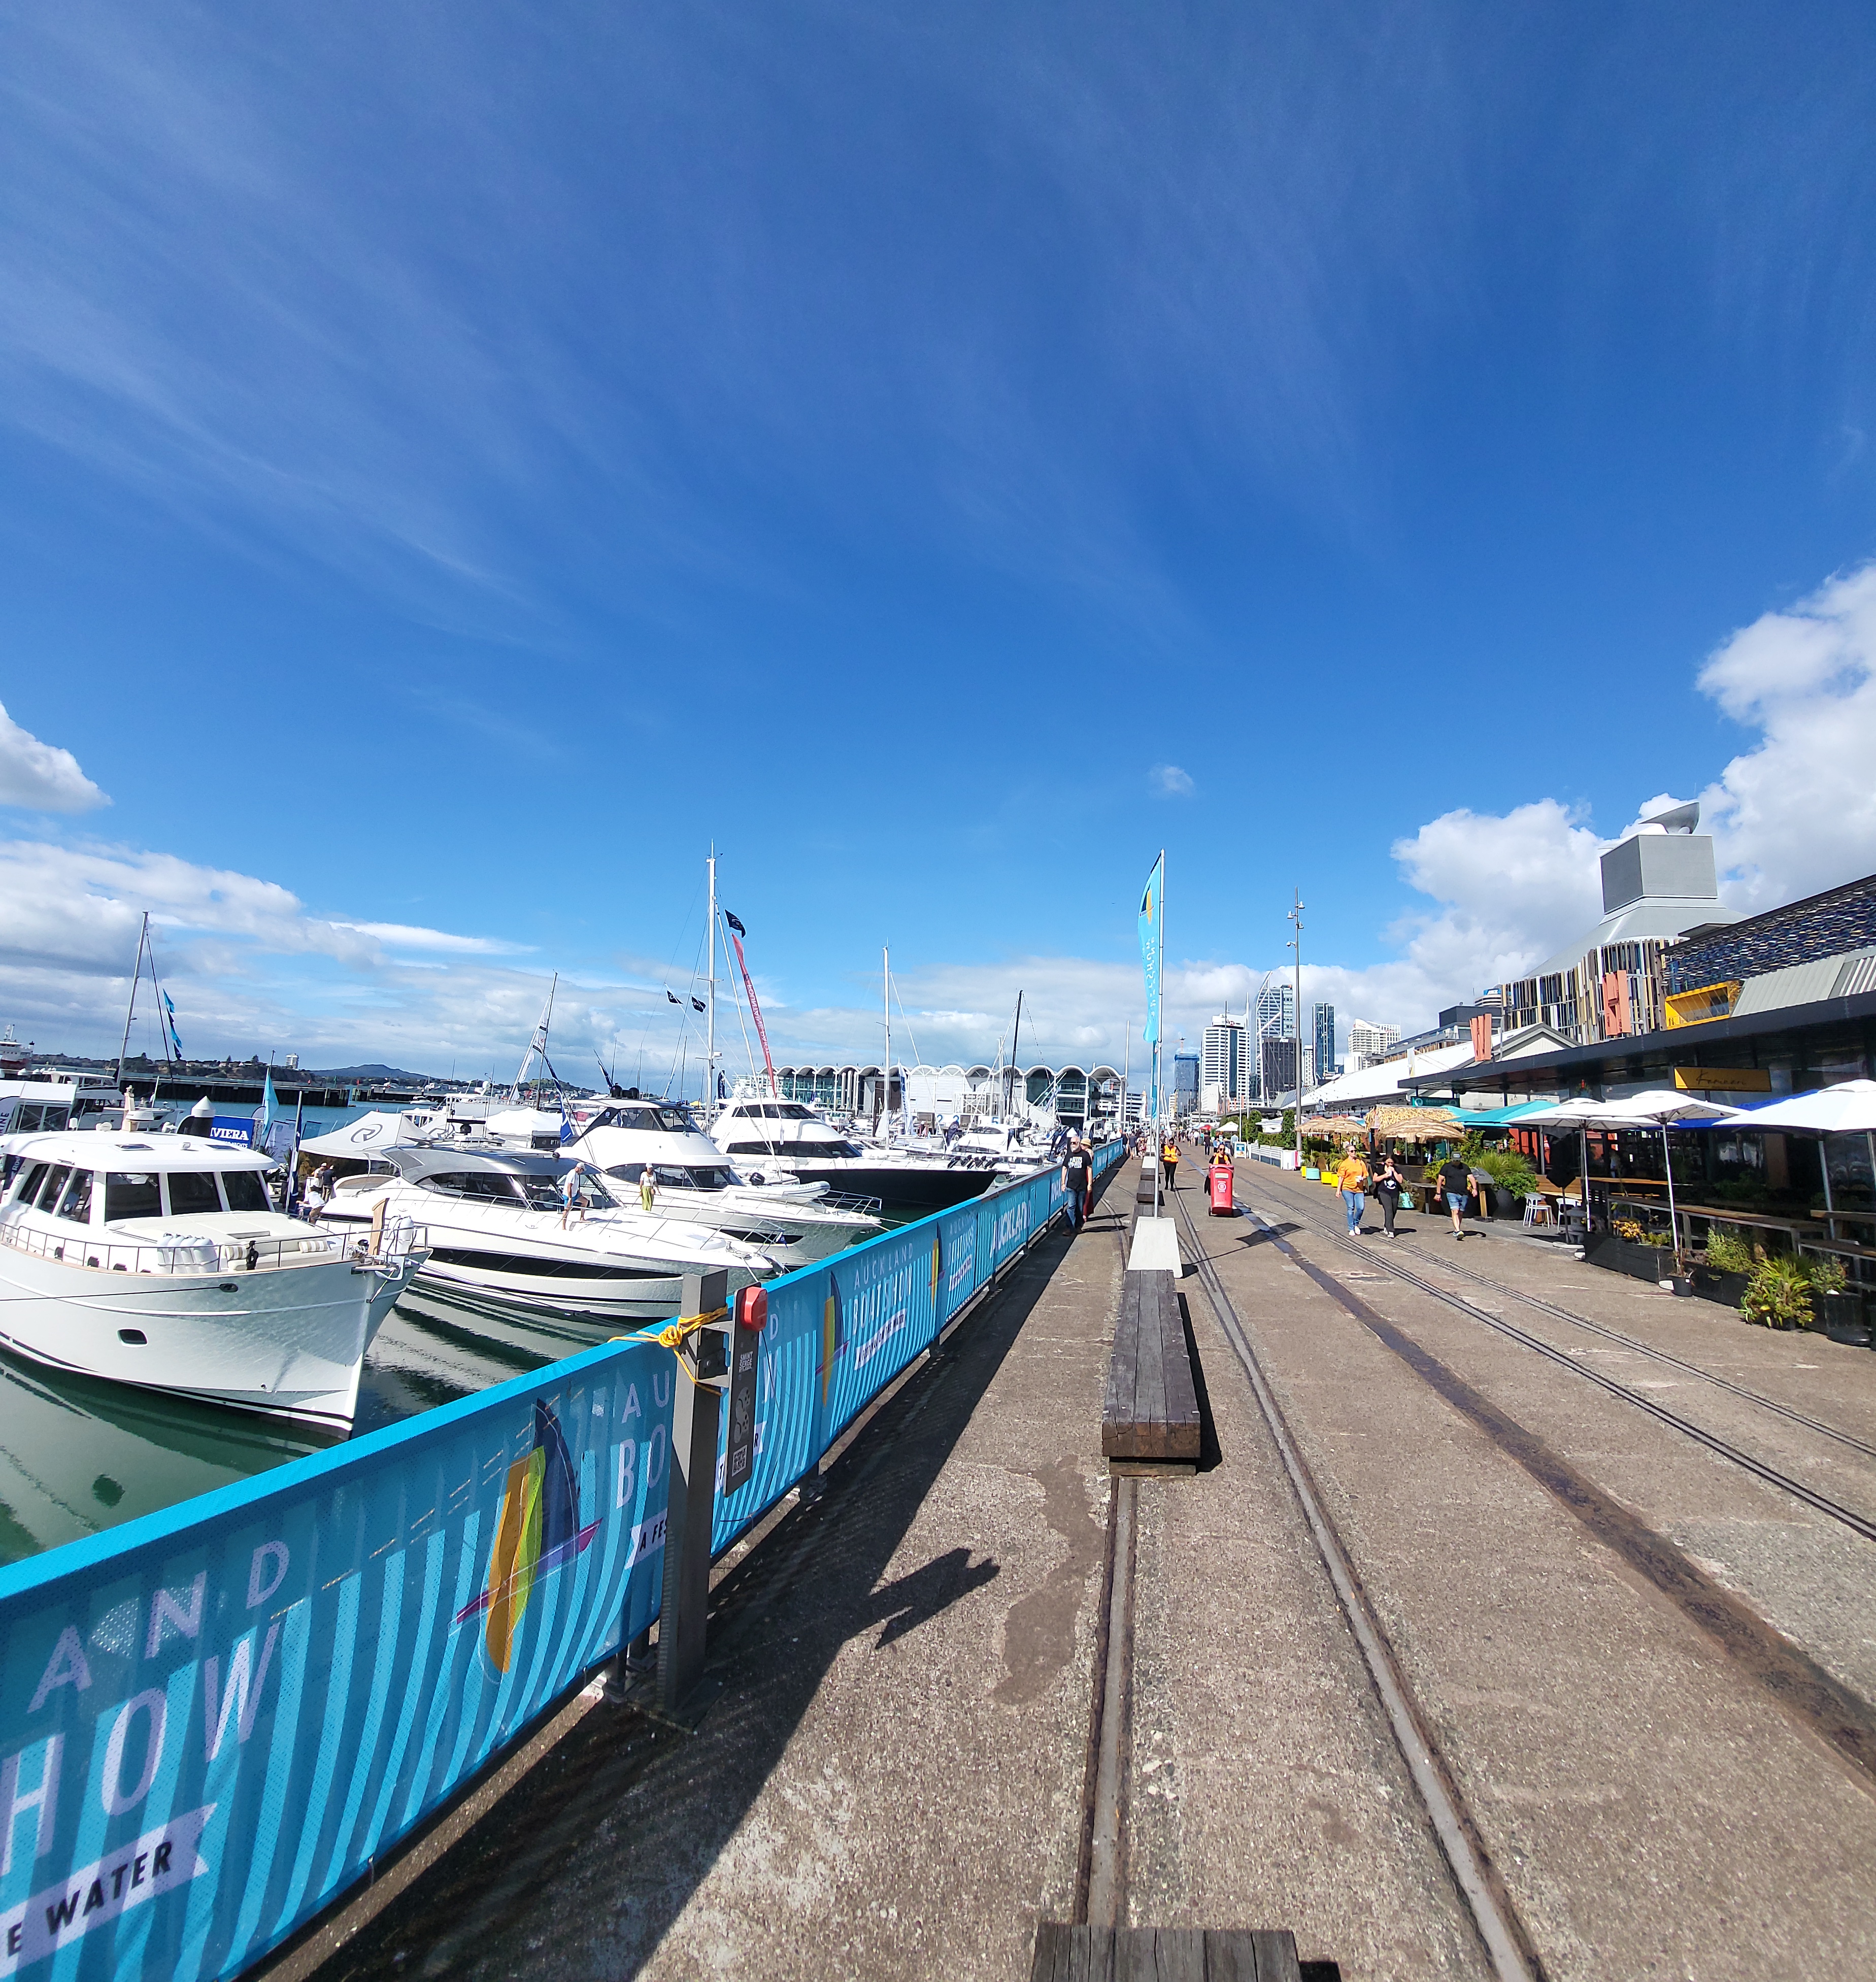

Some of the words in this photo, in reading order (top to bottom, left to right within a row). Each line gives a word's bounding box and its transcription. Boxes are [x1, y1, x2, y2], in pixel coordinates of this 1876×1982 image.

[854, 1243, 913, 1291] AUCKLAND
[858, 1352, 861, 1363] A
[862, 1337, 878, 1361] FESTIVAL
[879, 1330, 884, 1343] ON
[893, 1313, 904, 1327] WATER
[639, 1532, 647, 1552] A
[27, 1540, 290, 1713] AND
[0, 1623, 280, 1877] HOW
[7, 1922, 22, 1958] E
[45, 1840, 173, 1937] WATER
